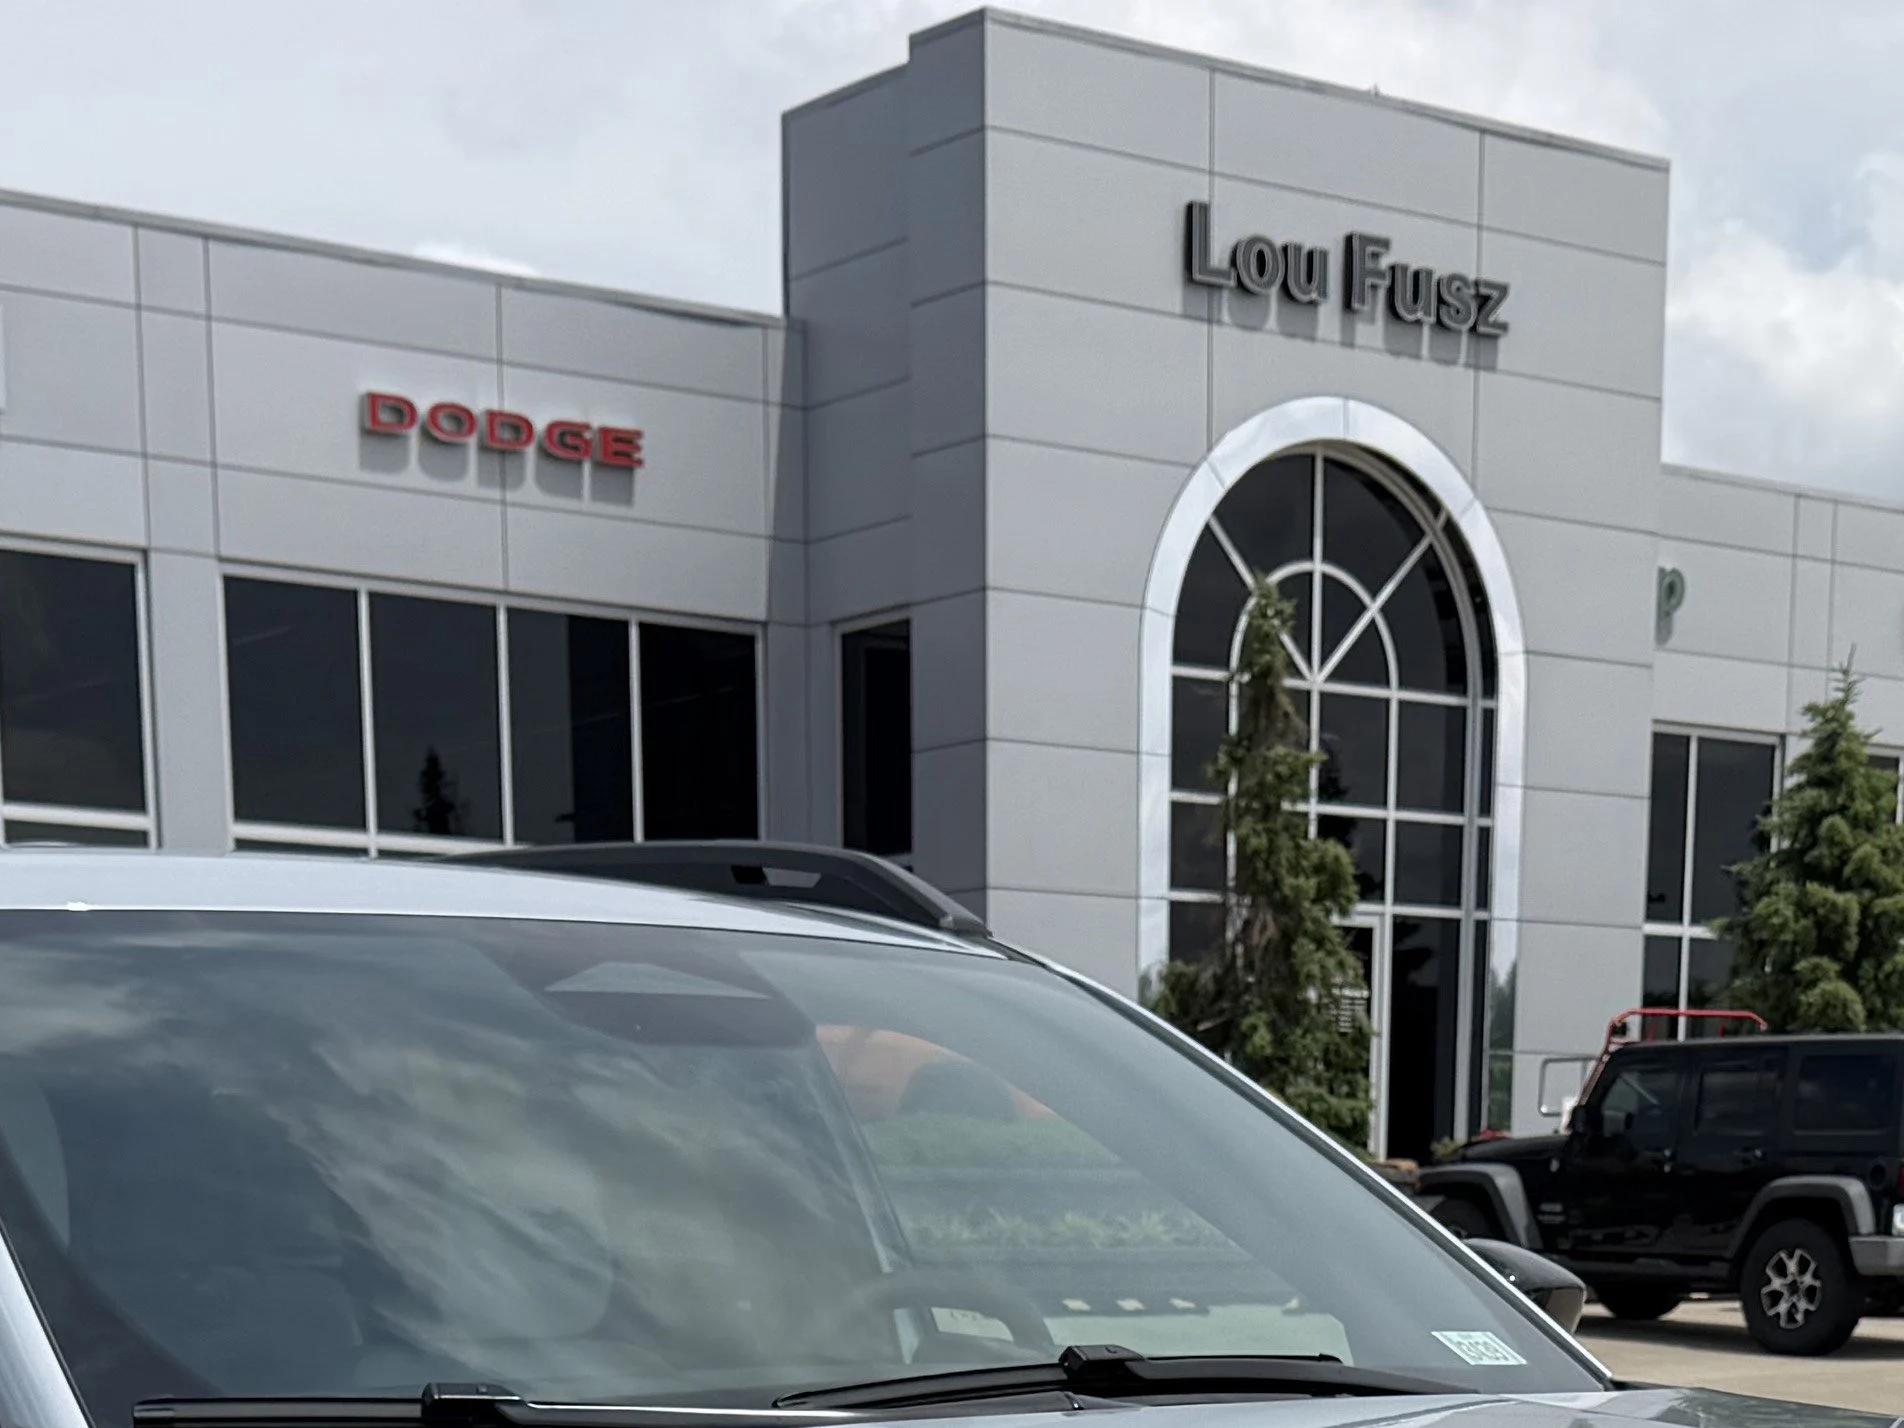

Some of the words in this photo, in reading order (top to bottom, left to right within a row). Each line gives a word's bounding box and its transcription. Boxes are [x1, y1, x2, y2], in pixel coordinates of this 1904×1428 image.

[1184, 200, 1328, 303] Lou
[1342, 231, 1510, 337] Fusz
[359, 391, 644, 468] DODGE
